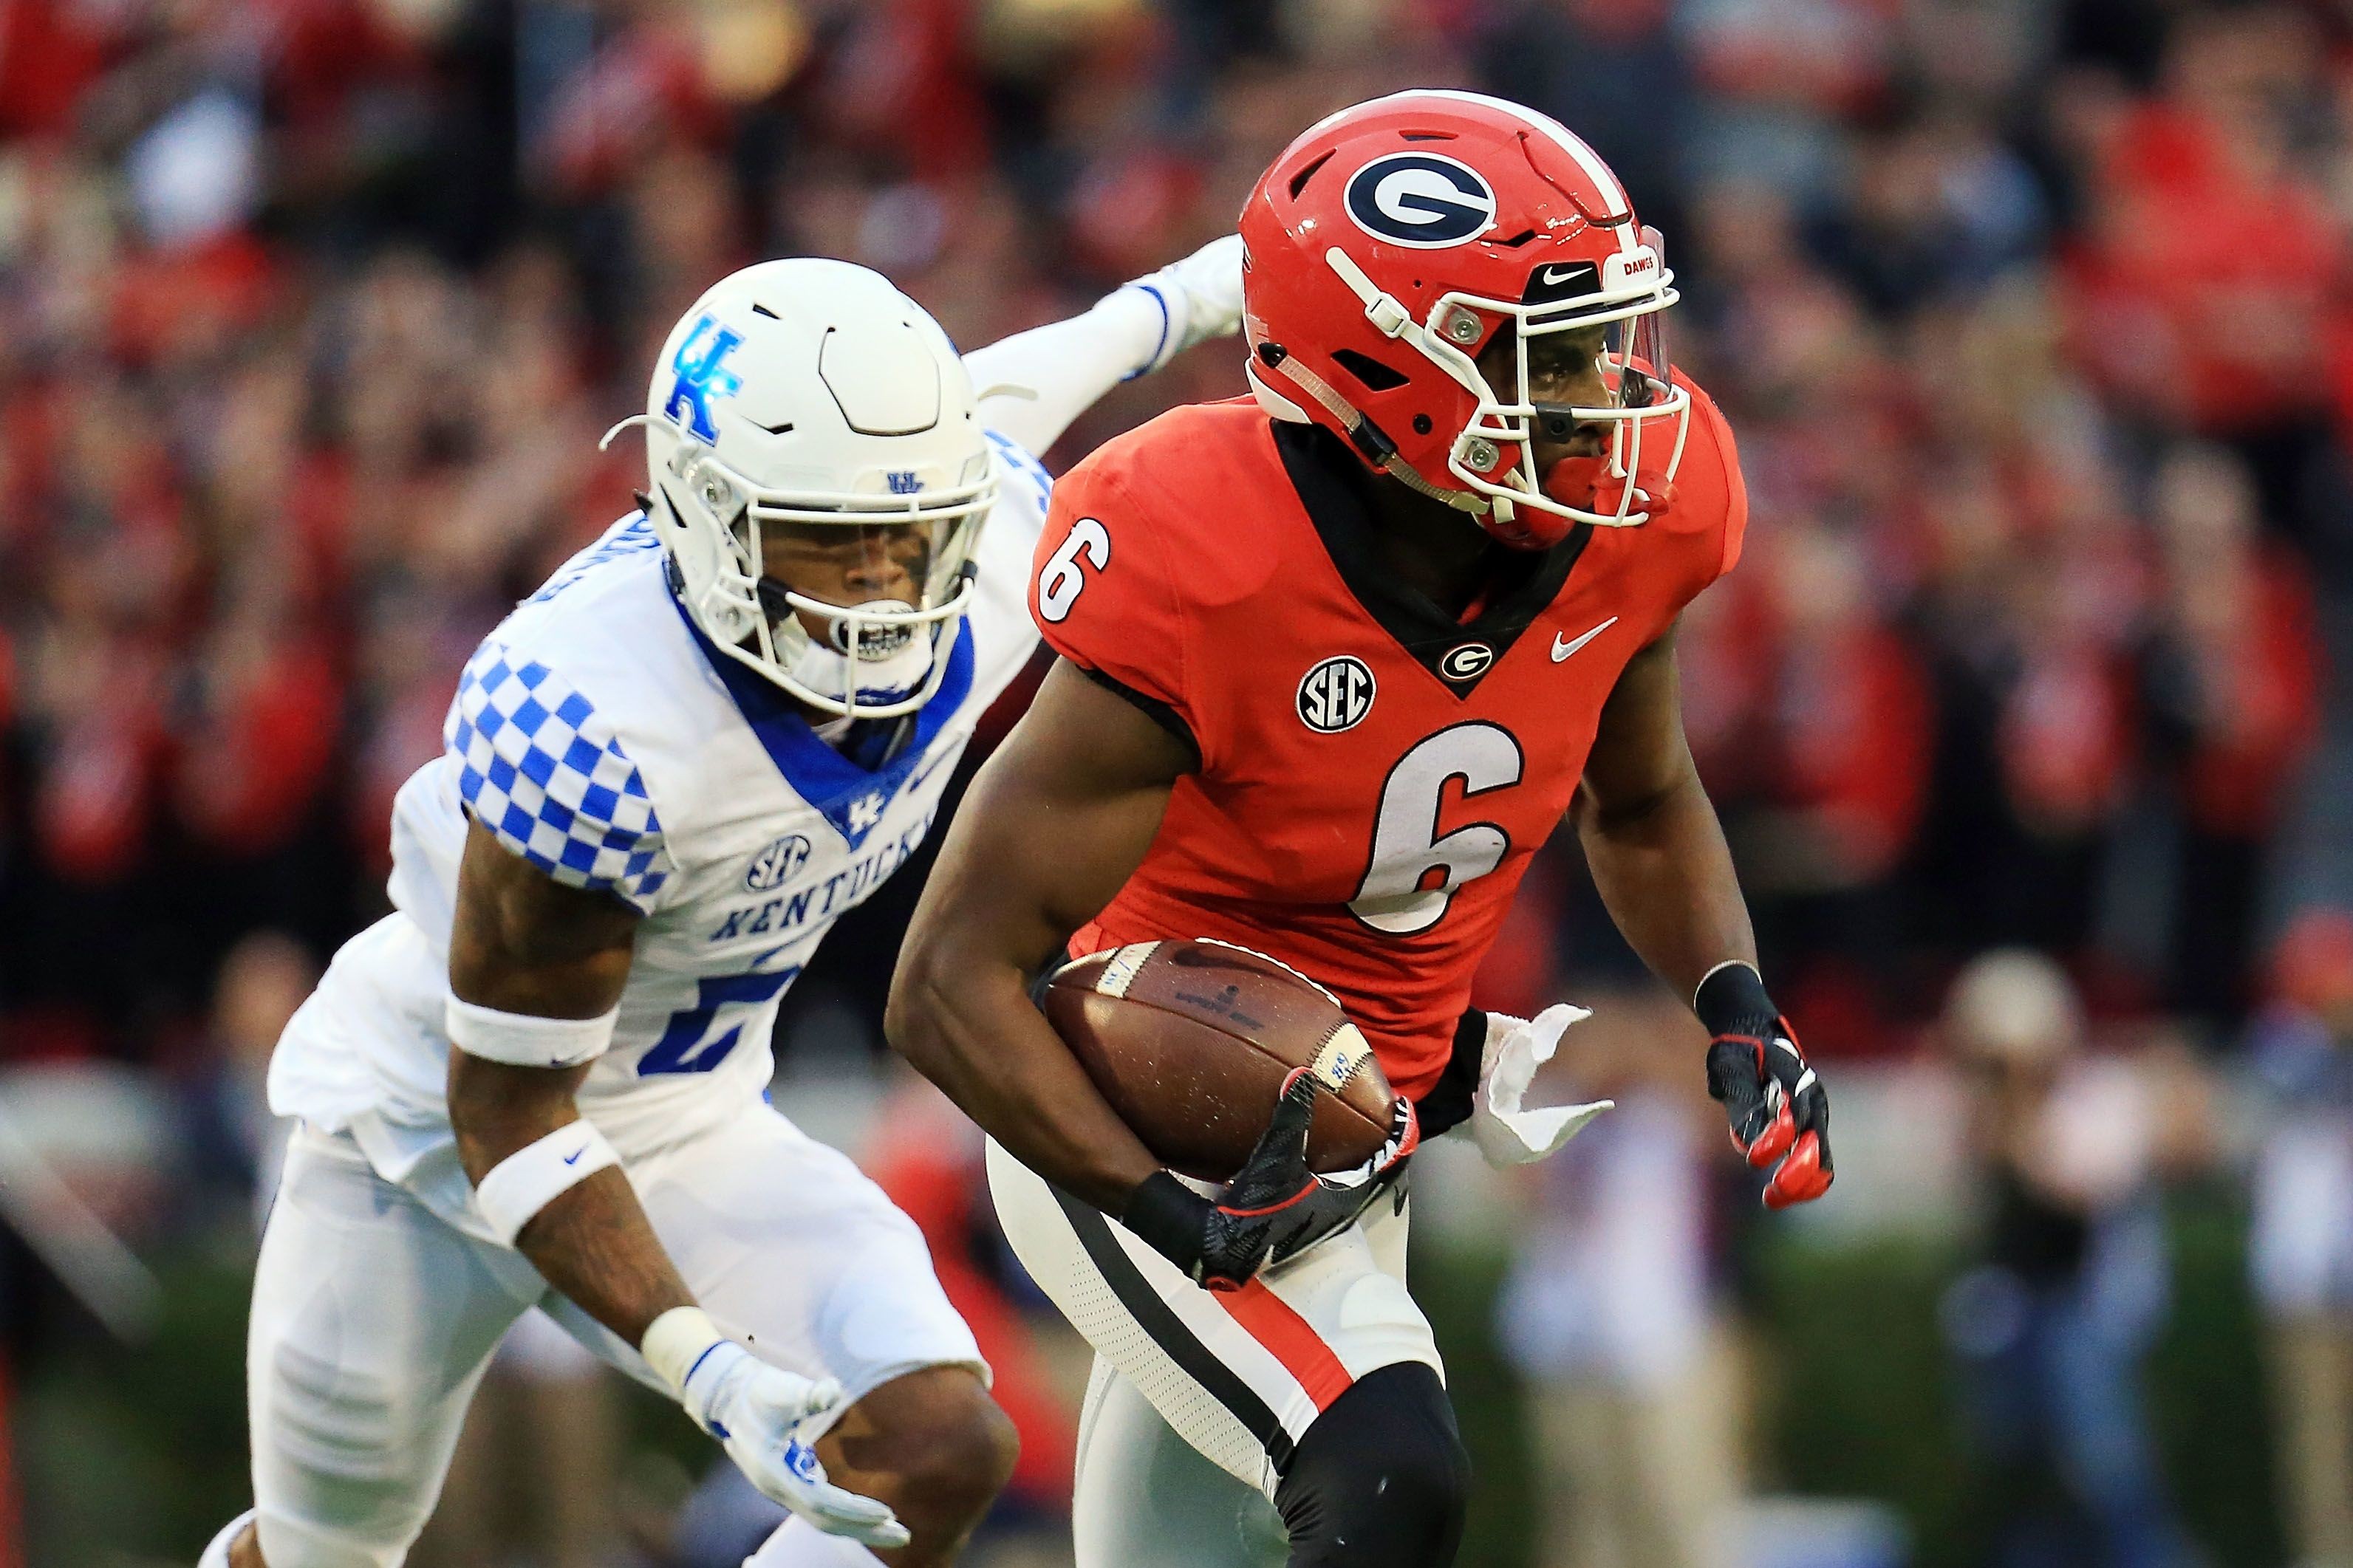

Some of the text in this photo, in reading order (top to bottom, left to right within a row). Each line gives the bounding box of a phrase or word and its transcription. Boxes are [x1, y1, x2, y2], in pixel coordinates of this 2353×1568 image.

[1348, 154, 1491, 244] G
[1624, 256, 1653, 275] DAWGS
[665, 314, 744, 448] UK
[1039, 518, 1110, 622] 6
[1302, 660, 1372, 733] SEC
[709, 812, 935, 942] KENTUCK
[747, 835, 810, 890] SEC
[1345, 721, 1525, 937] 6
